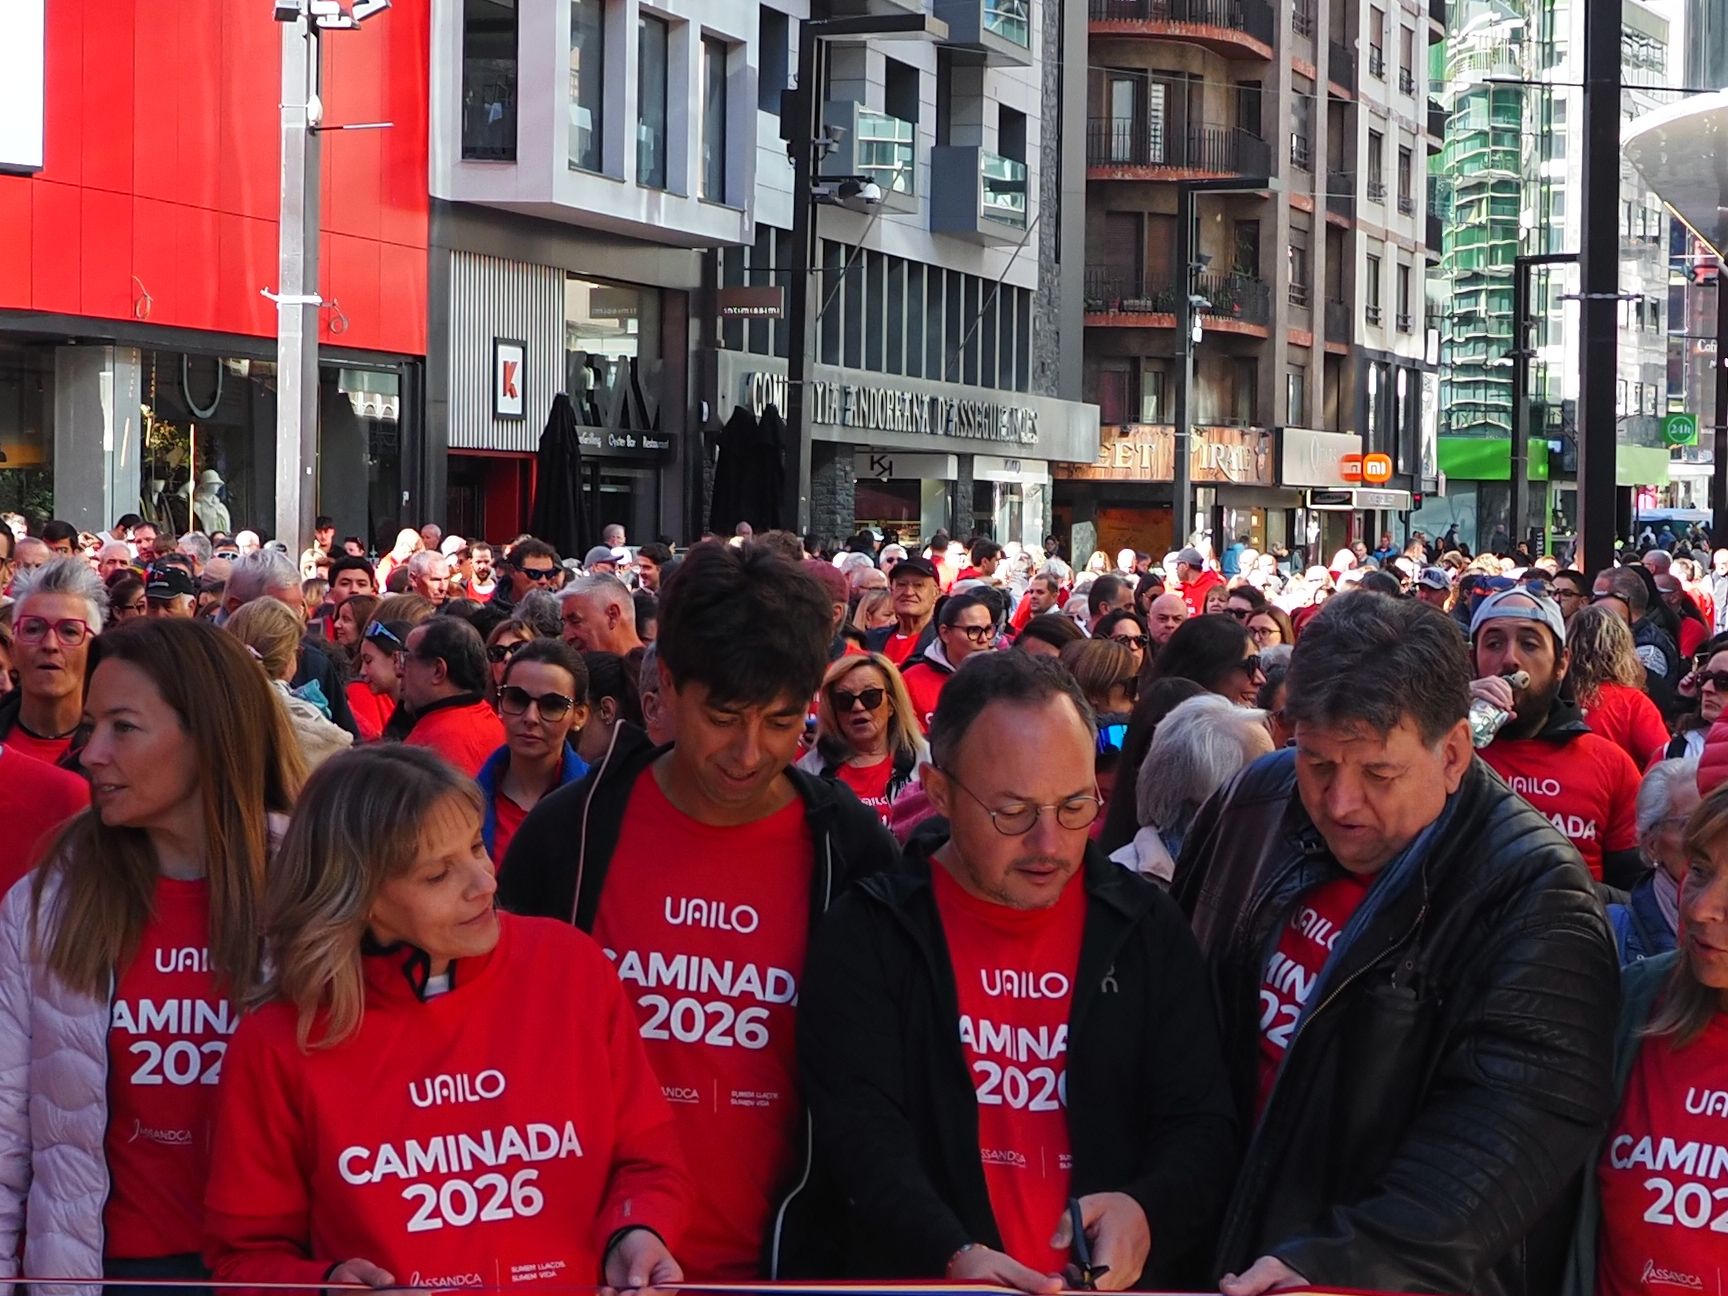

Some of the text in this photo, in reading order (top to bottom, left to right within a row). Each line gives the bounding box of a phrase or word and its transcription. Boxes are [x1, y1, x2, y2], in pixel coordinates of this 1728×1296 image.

[848, 384, 930, 433] ANDORRANA
[663, 894, 759, 934] UAILO
[980, 968, 1069, 999] UAILO
[638, 994, 770, 1050] 2026
[959, 1014, 1070, 1063] AMINA
[129, 1040, 225, 1086] 202
[409, 1070, 507, 1108] UAILO
[338, 1120, 584, 1187] CAMINADA
[400, 1170, 544, 1234] 2026
